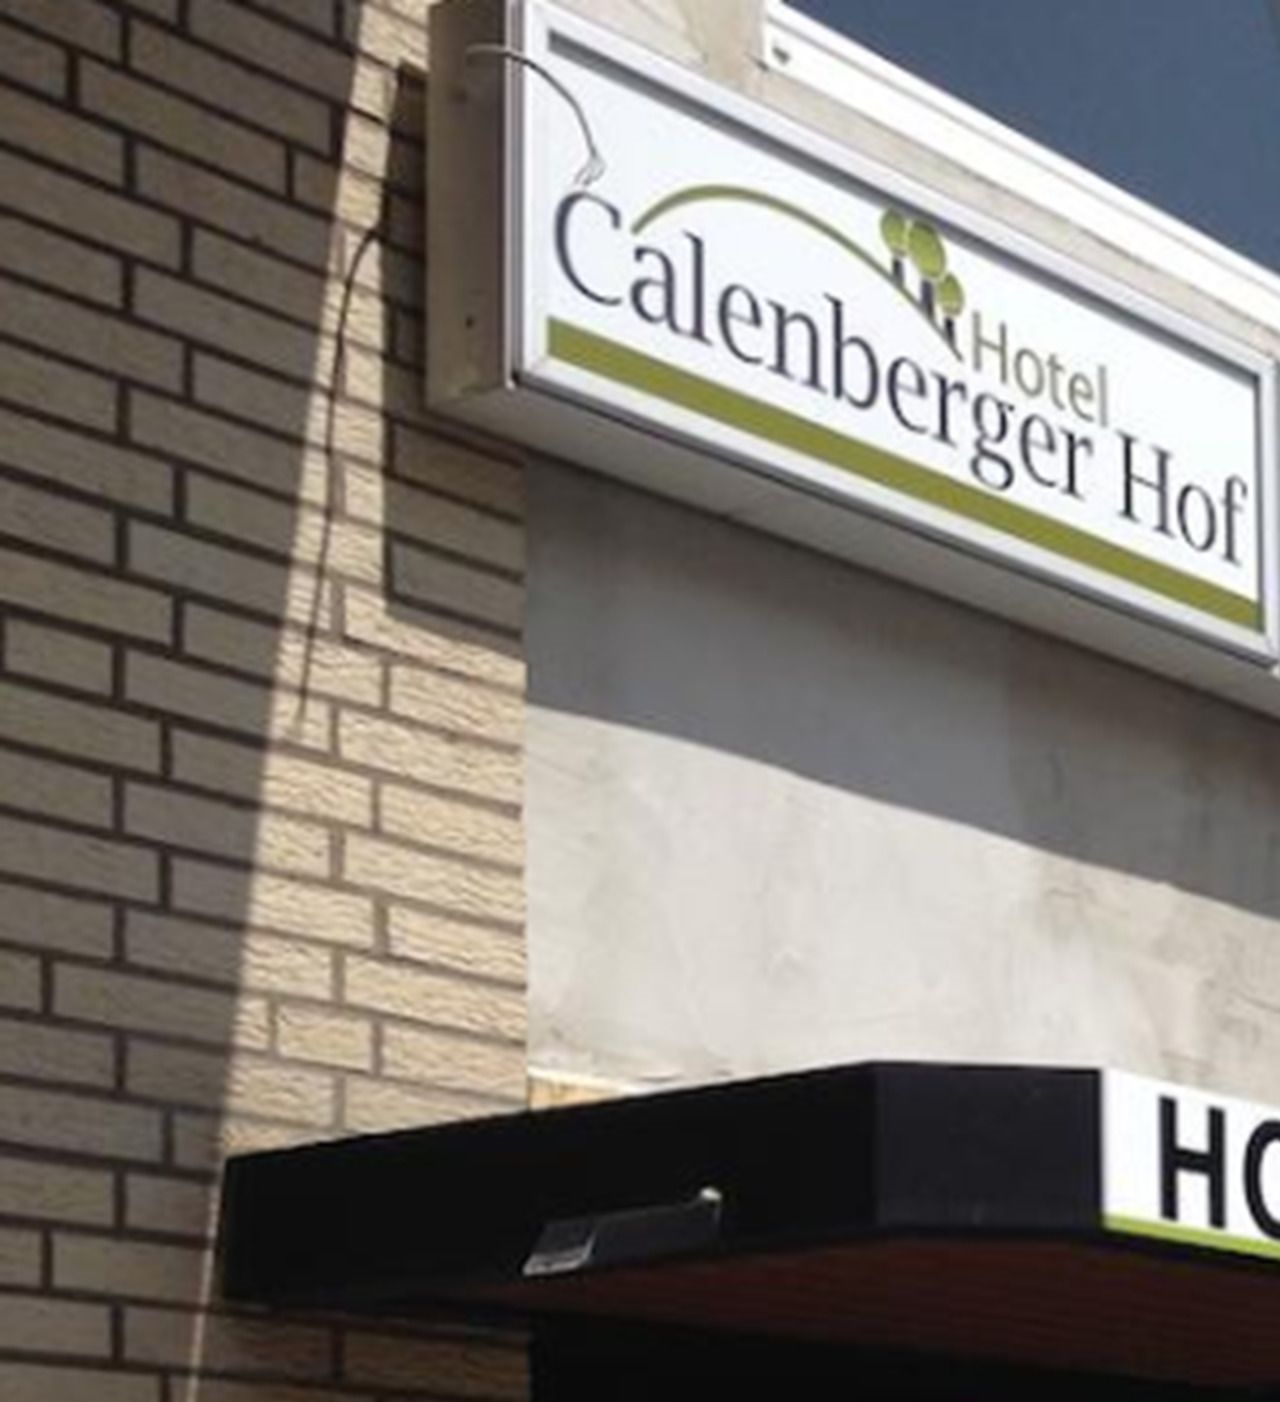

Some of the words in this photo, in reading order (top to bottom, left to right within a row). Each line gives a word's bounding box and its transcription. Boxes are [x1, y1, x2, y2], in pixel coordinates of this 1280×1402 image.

[553, 191, 1093, 504] Calenberger
[1117, 432, 1248, 567] Hof
[971, 310, 1108, 428] Hotel
